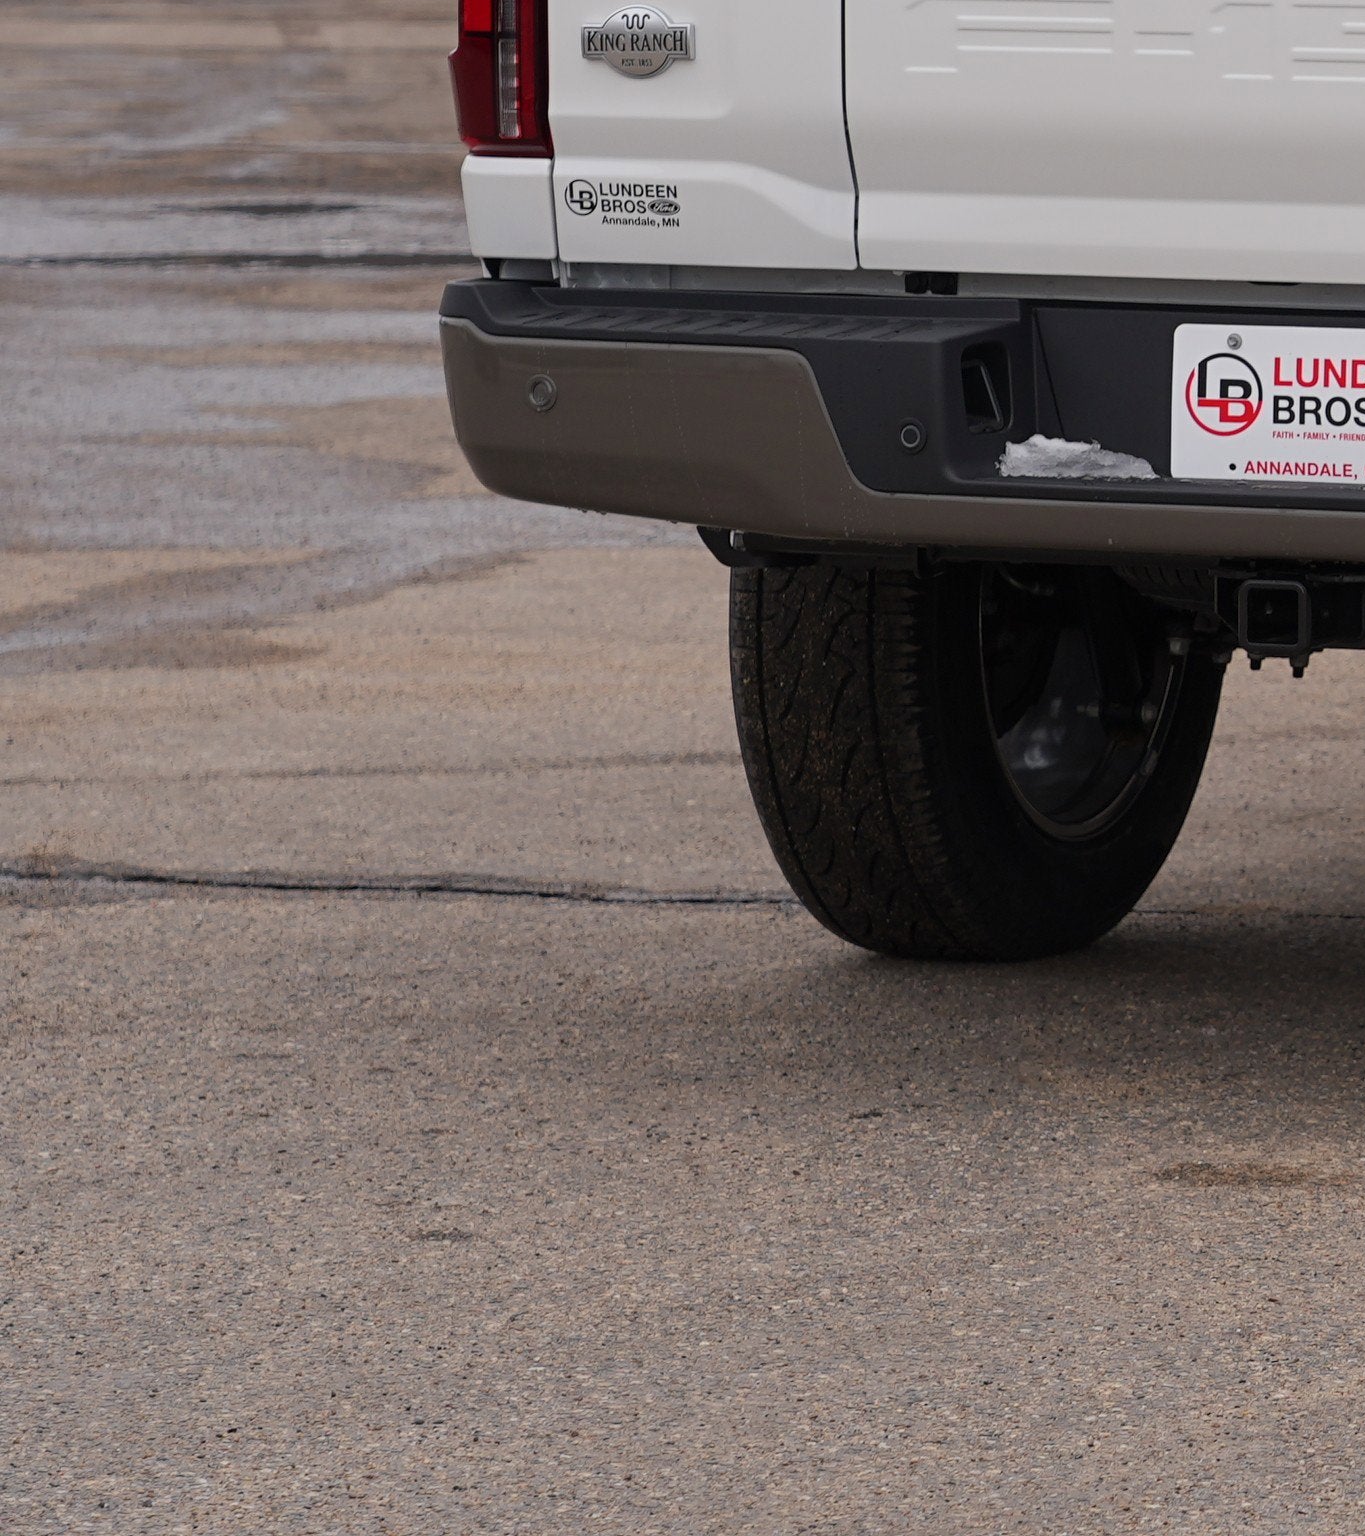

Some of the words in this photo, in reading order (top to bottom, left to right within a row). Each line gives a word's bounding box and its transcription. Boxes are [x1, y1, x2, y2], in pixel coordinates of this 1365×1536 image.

[587, 31, 626, 52] KING
[630, 30, 685, 52] RANCH
[599, 182, 678, 199] LUNDEEN
[601, 199, 647, 214] BROS
[602, 215, 660, 228] Annandale,
[662, 217, 680, 228] MN
[1272, 430, 1294, 439] FAITH
[1303, 432, 1330, 441] FAMILY
[1244, 460, 1358, 480] ANNANDALE,
